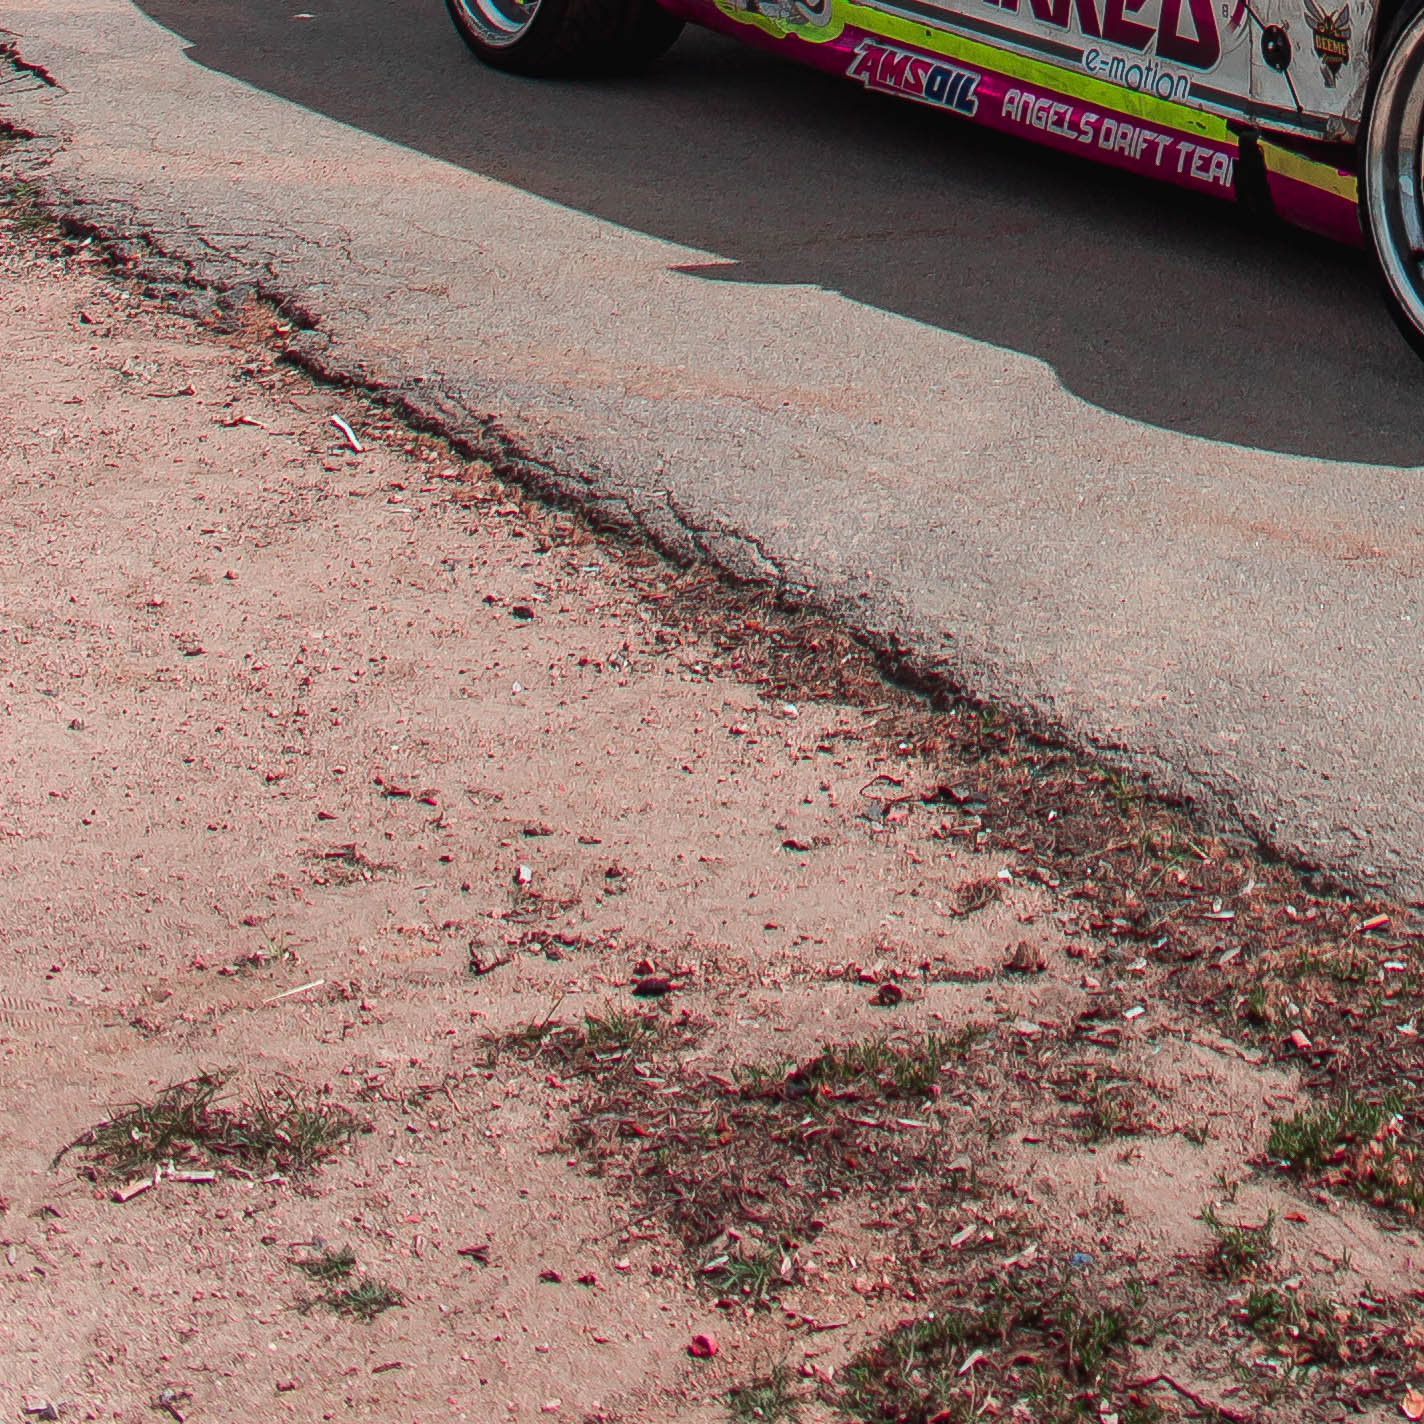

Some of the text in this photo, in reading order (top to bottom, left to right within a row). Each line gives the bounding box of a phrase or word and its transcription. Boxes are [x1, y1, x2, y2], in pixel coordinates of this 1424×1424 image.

[850, 41, 981, 115] AMSOIL
[1083, 47, 1192, 101] e-motion
[1001, 87, 1099, 141] ANGELS
[1098, 118, 1175, 167] DRIFT
